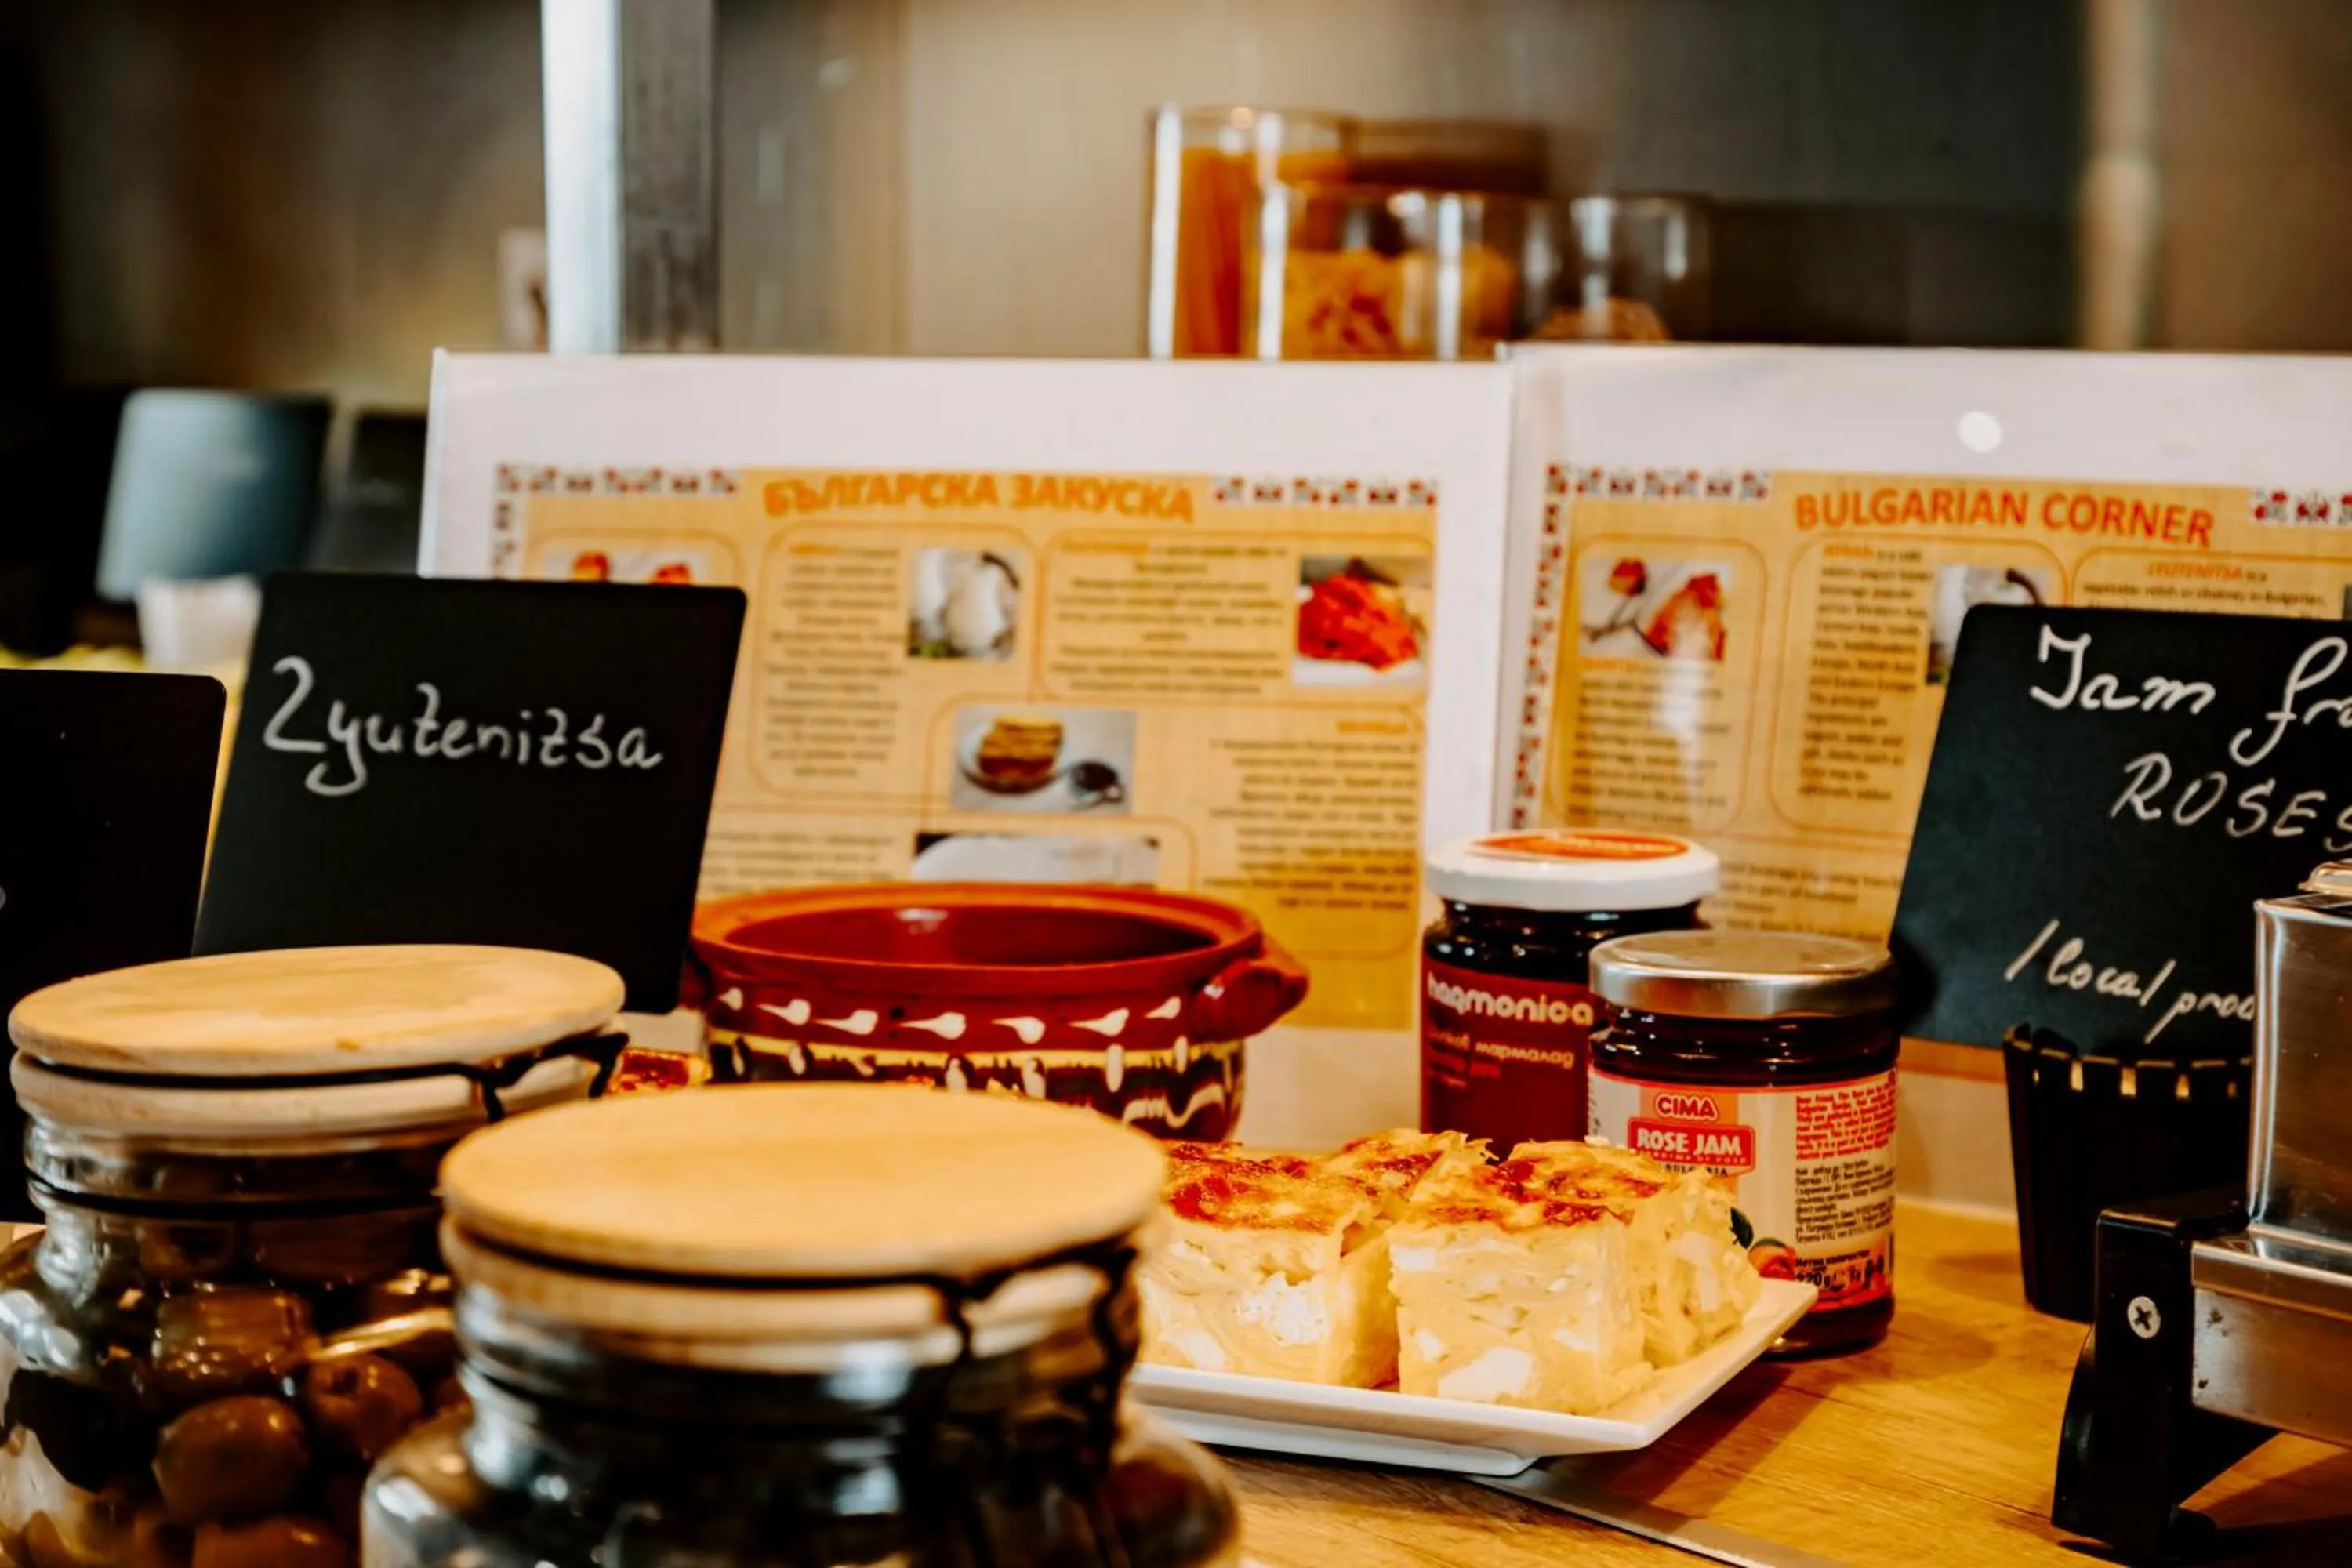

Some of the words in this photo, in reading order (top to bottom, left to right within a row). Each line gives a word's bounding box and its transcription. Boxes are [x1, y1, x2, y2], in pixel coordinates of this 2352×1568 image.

[763, 474, 1000, 518] БЪЛГАРСКА
[1009, 474, 1195, 524] ЗАКУСКА
[1795, 488, 2028, 531] BULGARIAN
[2042, 492, 2216, 547] CORNER
[2029, 625, 2216, 714] Jam
[1657, 1096, 1715, 1119] CIMA
[1636, 1127, 1690, 1153] ROSE
[1693, 1134, 1743, 1156] JAM
